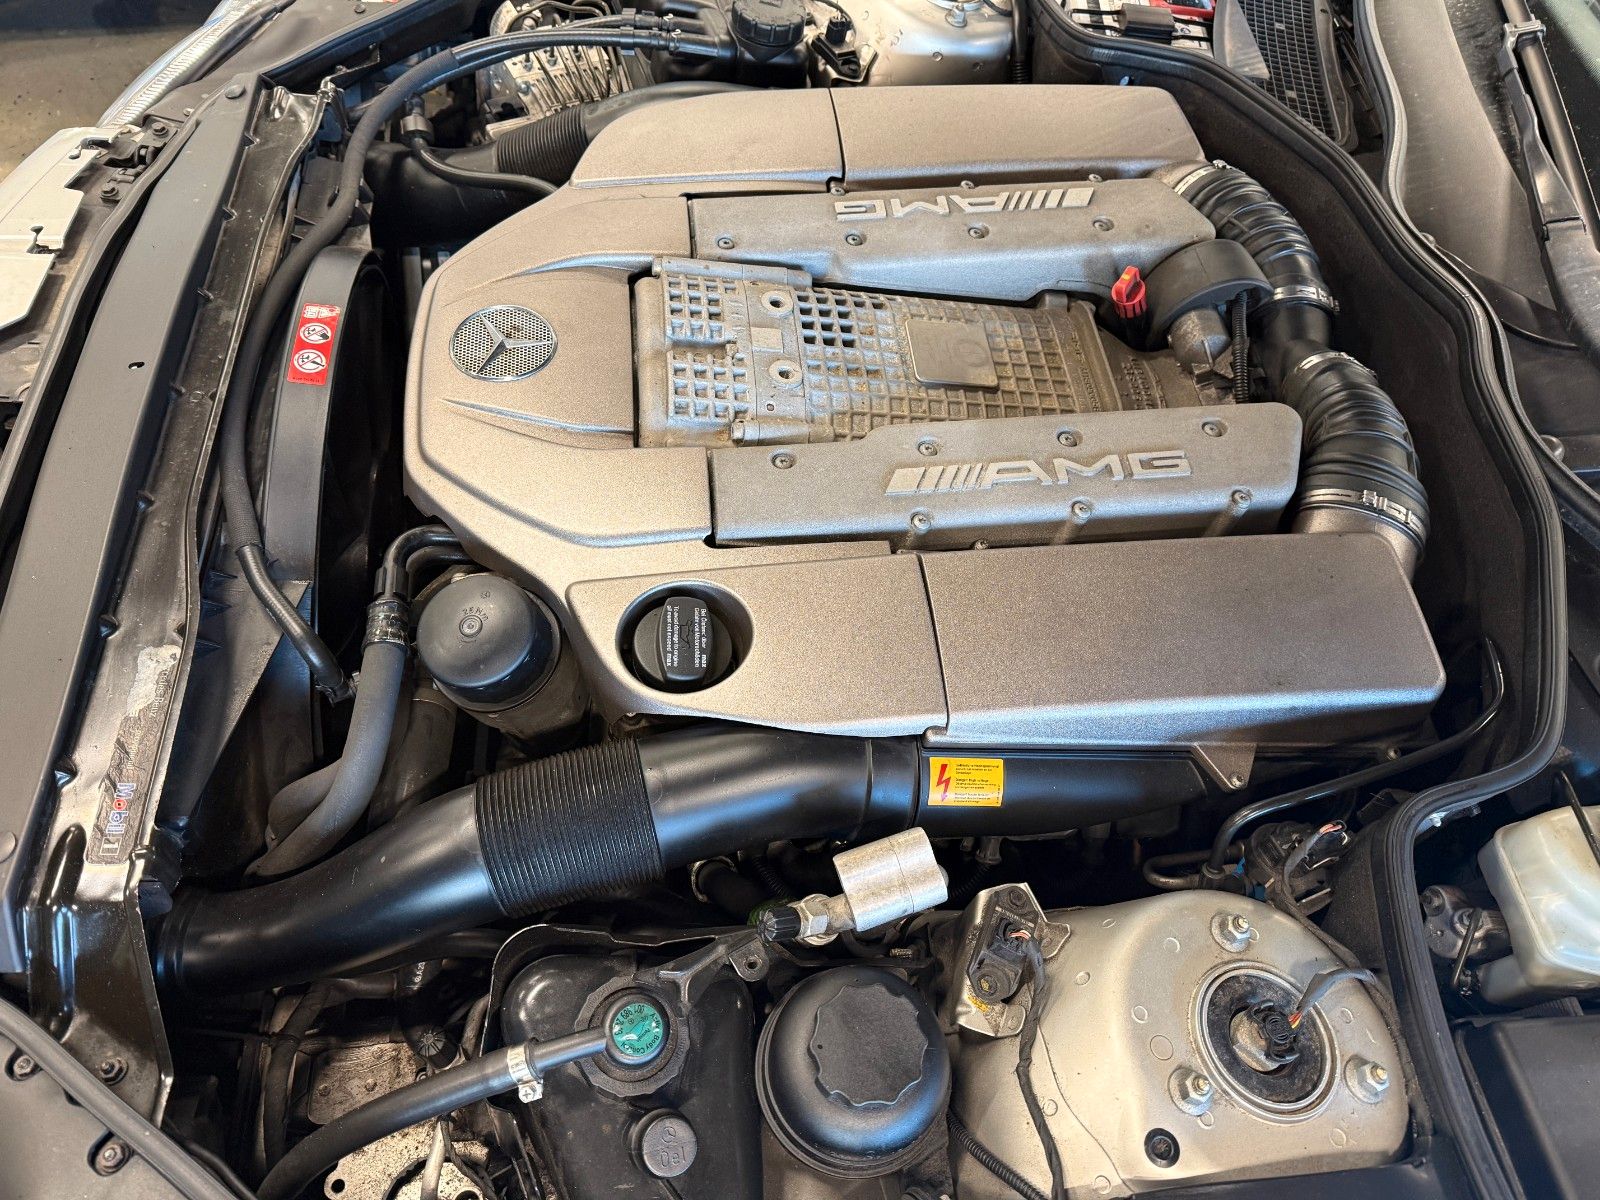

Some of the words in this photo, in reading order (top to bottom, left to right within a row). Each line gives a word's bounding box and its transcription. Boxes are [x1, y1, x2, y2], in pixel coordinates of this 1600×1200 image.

[834, 191, 1010, 221] AMG
[978, 450, 1192, 488] AMG
[672, 624, 680, 644] damage
[105, 782, 137, 834] Mobil
[646, 1034, 660, 1050] Body
